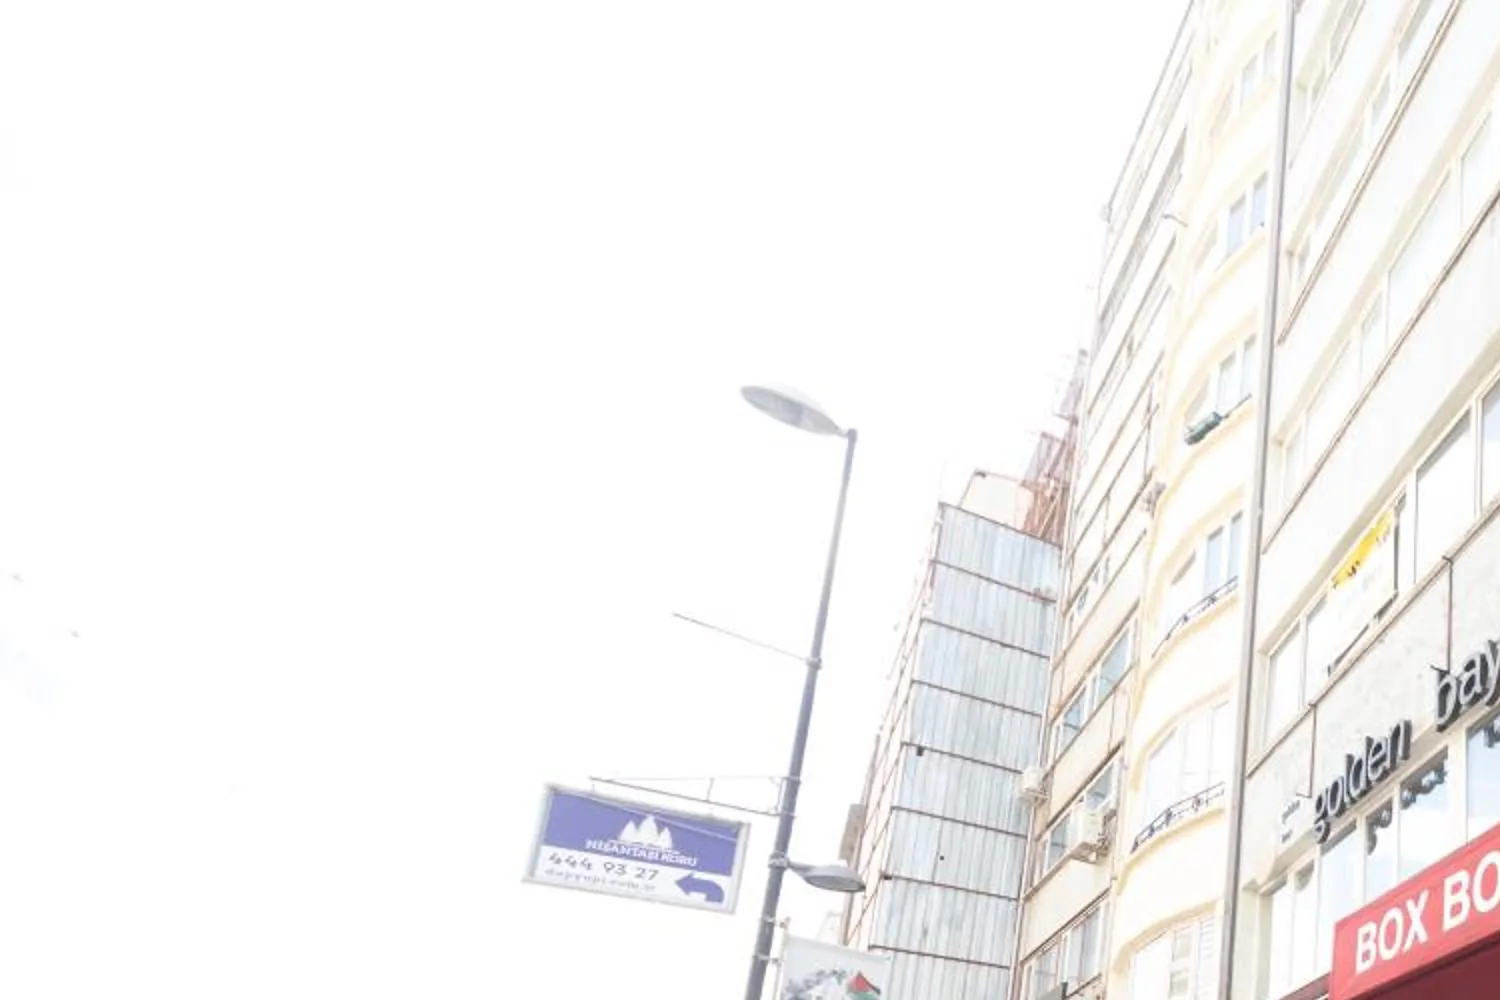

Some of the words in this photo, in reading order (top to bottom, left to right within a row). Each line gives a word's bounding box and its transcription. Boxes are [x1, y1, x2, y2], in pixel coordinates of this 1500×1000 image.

[1313, 719, 1412, 844] golden
[549, 852, 593, 870] 444
[634, 867, 660, 881] 27
[1354, 889, 1429, 976] BOX
